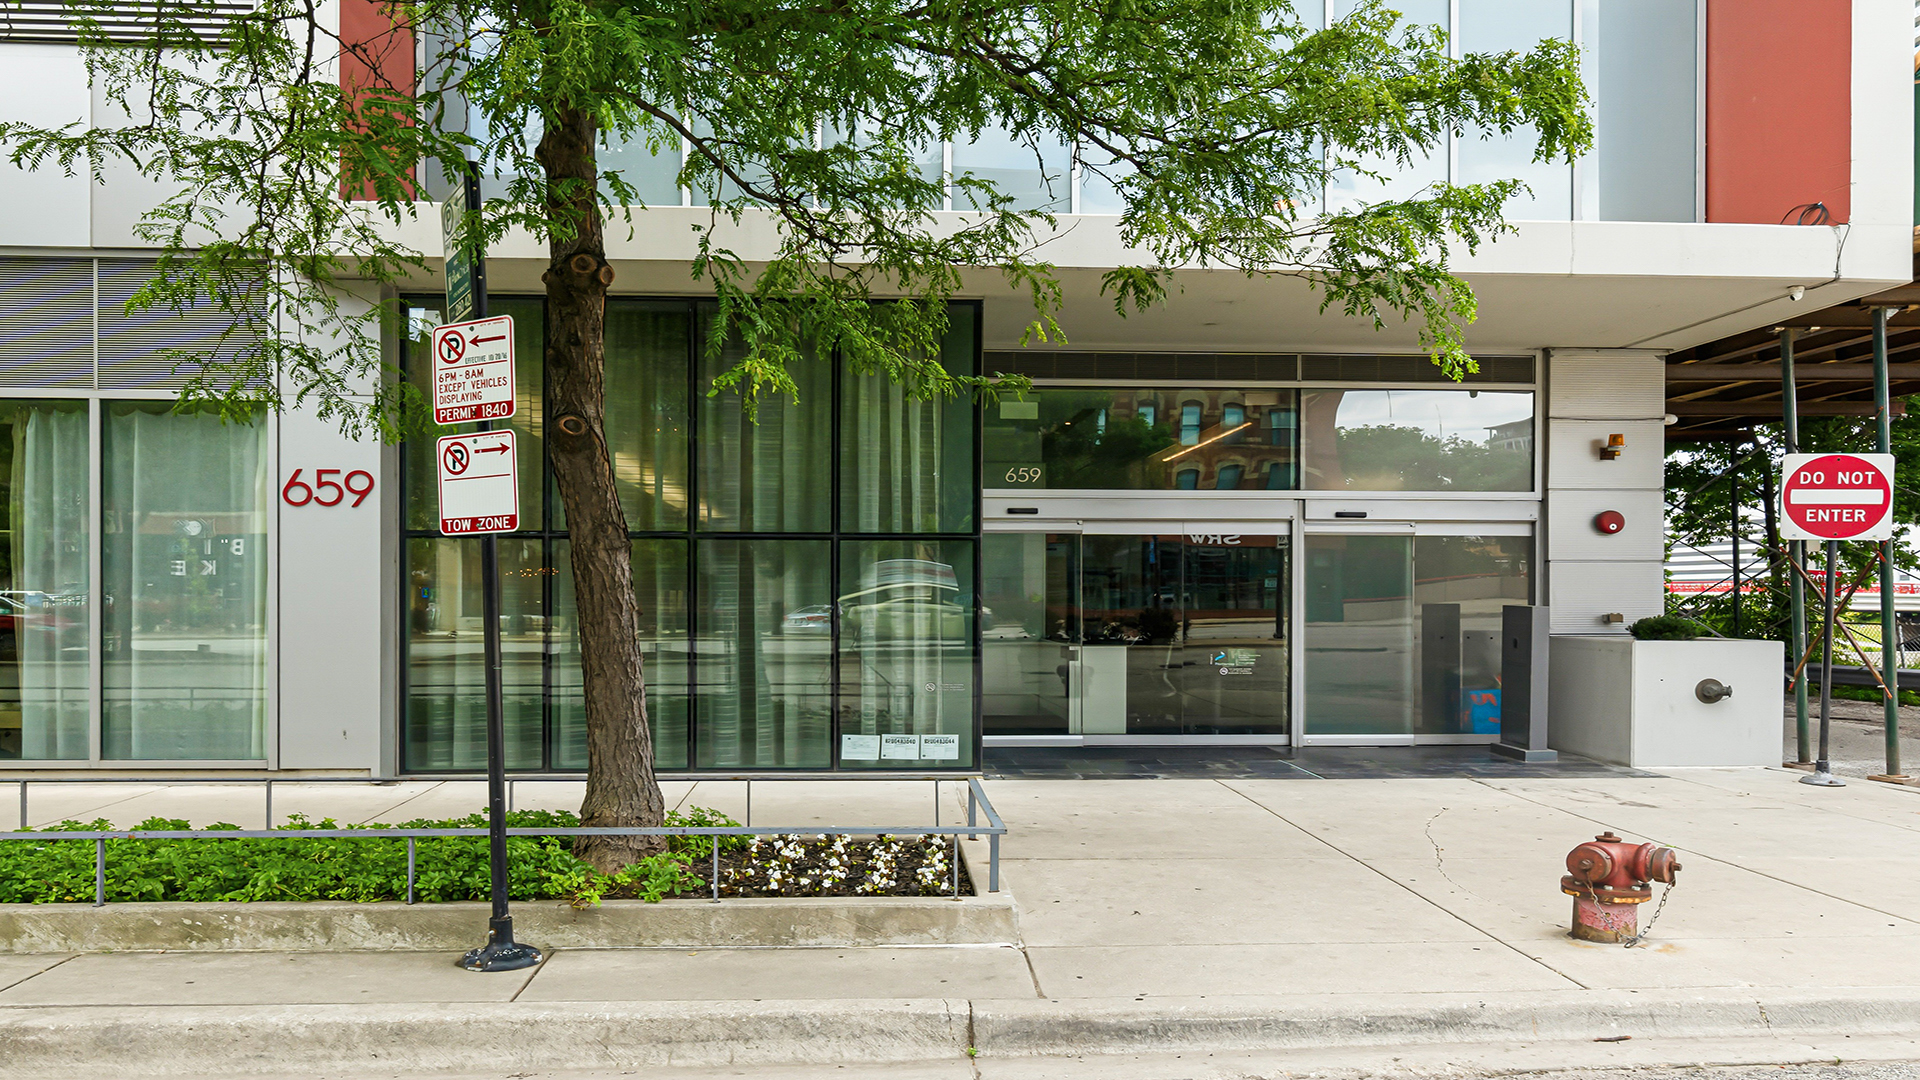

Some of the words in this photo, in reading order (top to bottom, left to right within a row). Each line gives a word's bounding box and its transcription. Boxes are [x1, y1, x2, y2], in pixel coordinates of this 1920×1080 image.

[438, 372, 457, 383] 6PM
[465, 368, 484, 380] 8AM
[439, 381, 467, 394] EXCEPT
[471, 376, 508, 390] VEHICLES
[439, 390, 483, 405] DISPLAYING
[440, 406, 477, 421] PERMIT
[481, 402, 508, 417] 1840
[1005, 466, 1042, 483] 659
[1800, 471, 1825, 485] DO
[1837, 471, 1876, 485] NOT
[282, 468, 375, 508] 659
[1806, 509, 1867, 522] ENTER
[445, 519, 472, 532] TOW
[477, 516, 511, 530] ZONE
